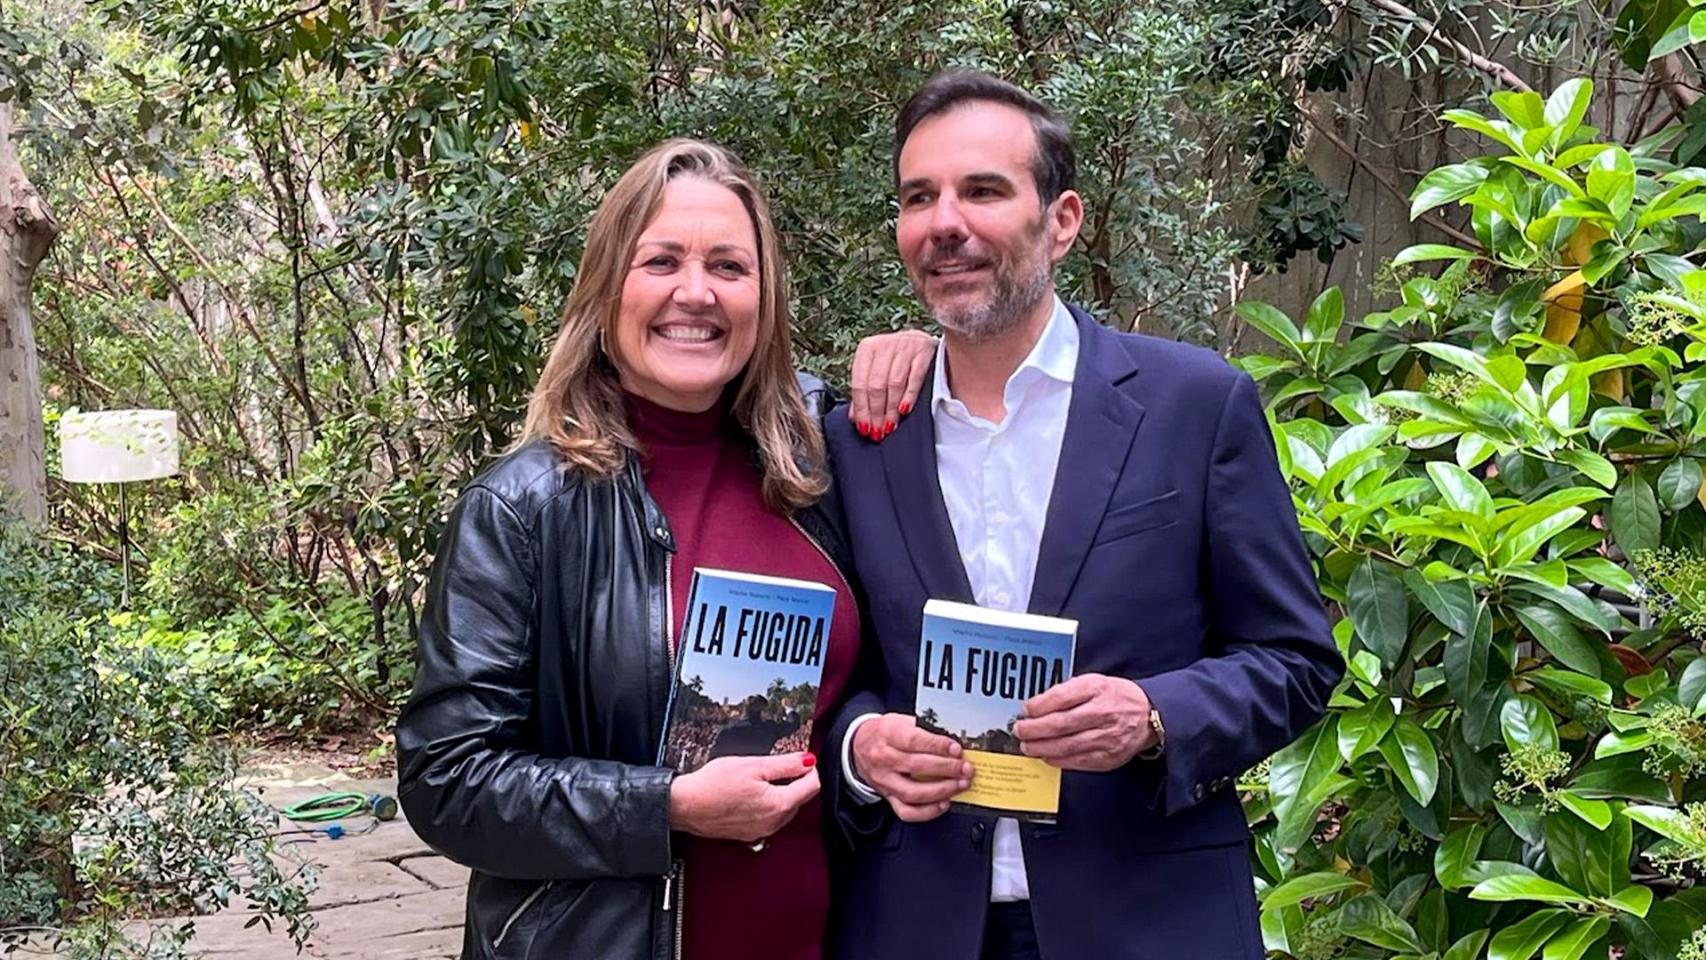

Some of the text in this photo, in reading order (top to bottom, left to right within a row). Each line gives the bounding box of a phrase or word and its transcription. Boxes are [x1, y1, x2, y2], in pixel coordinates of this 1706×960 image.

[694, 603, 825, 667] LA FUGIDA
[923, 640, 953, 690] LA
